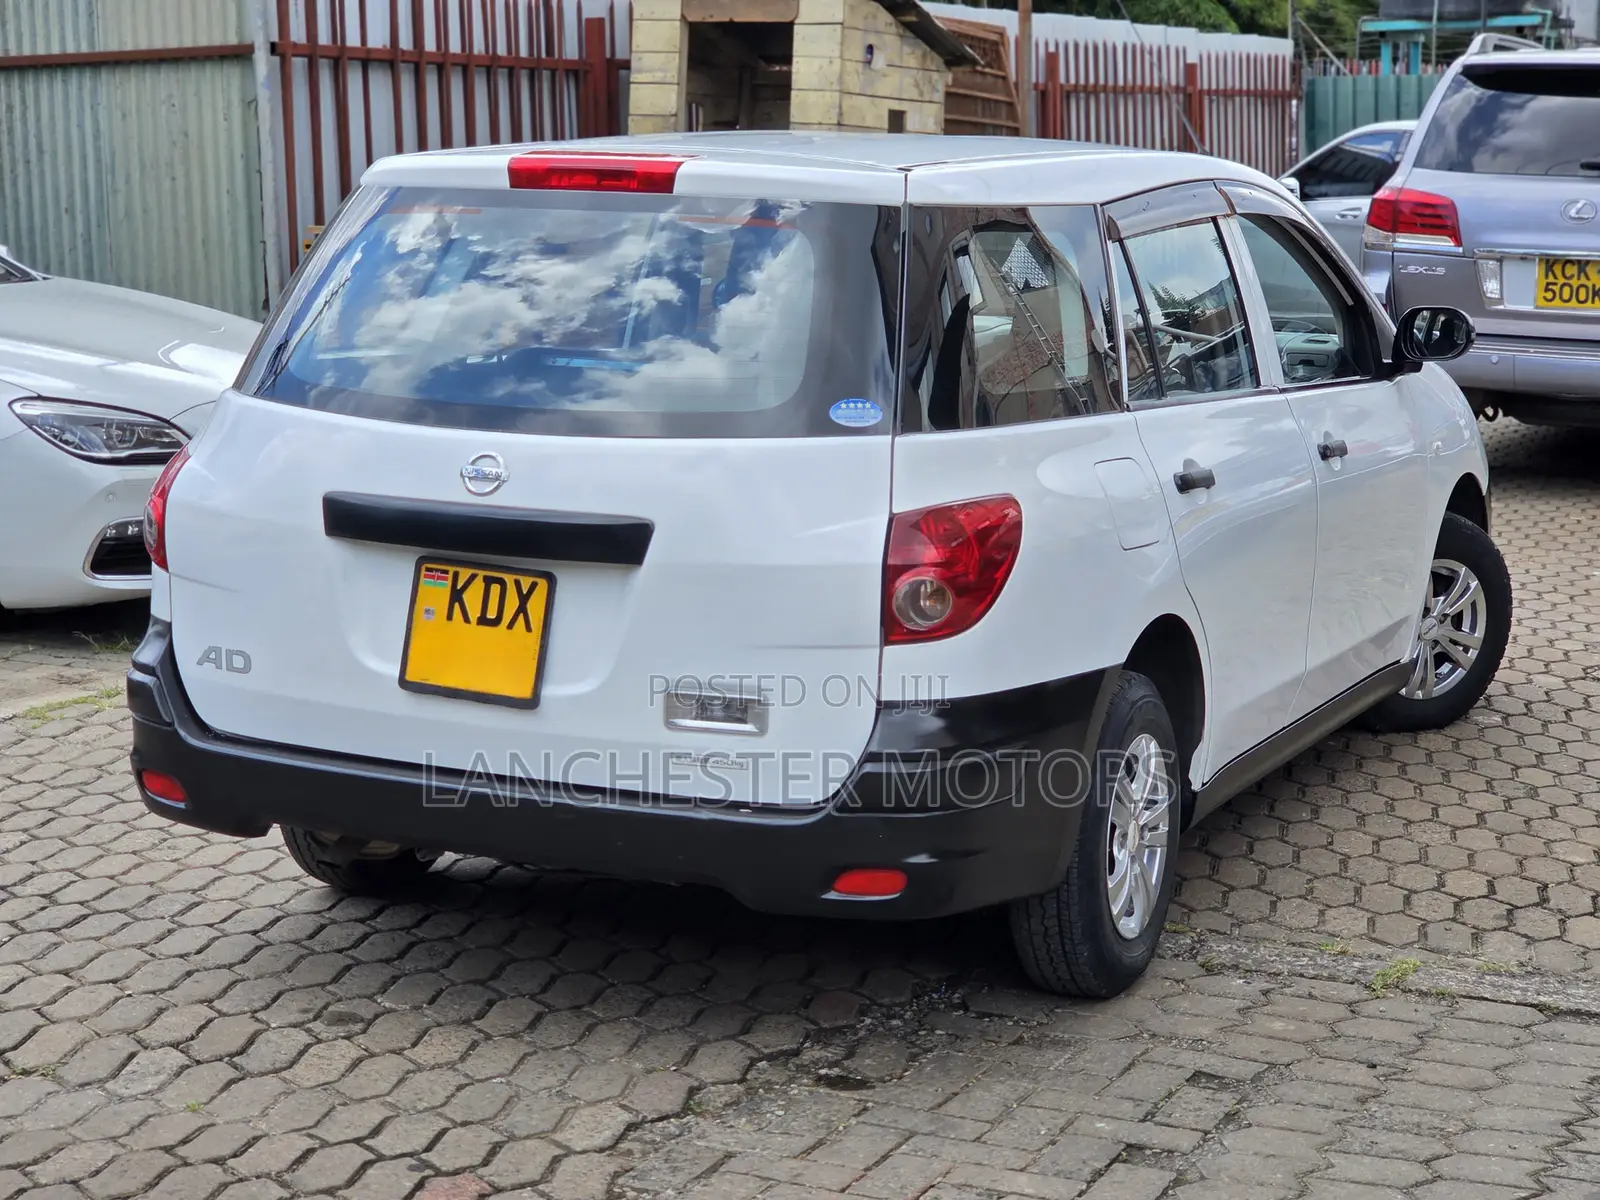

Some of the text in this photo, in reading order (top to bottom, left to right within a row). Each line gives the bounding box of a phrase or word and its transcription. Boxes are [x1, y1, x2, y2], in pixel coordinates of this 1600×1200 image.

[1544, 259, 1591, 281] KCK
[464, 468, 503, 478] NISSAN
[446, 570, 539, 633] KDX
[196, 646, 252, 674] AD
